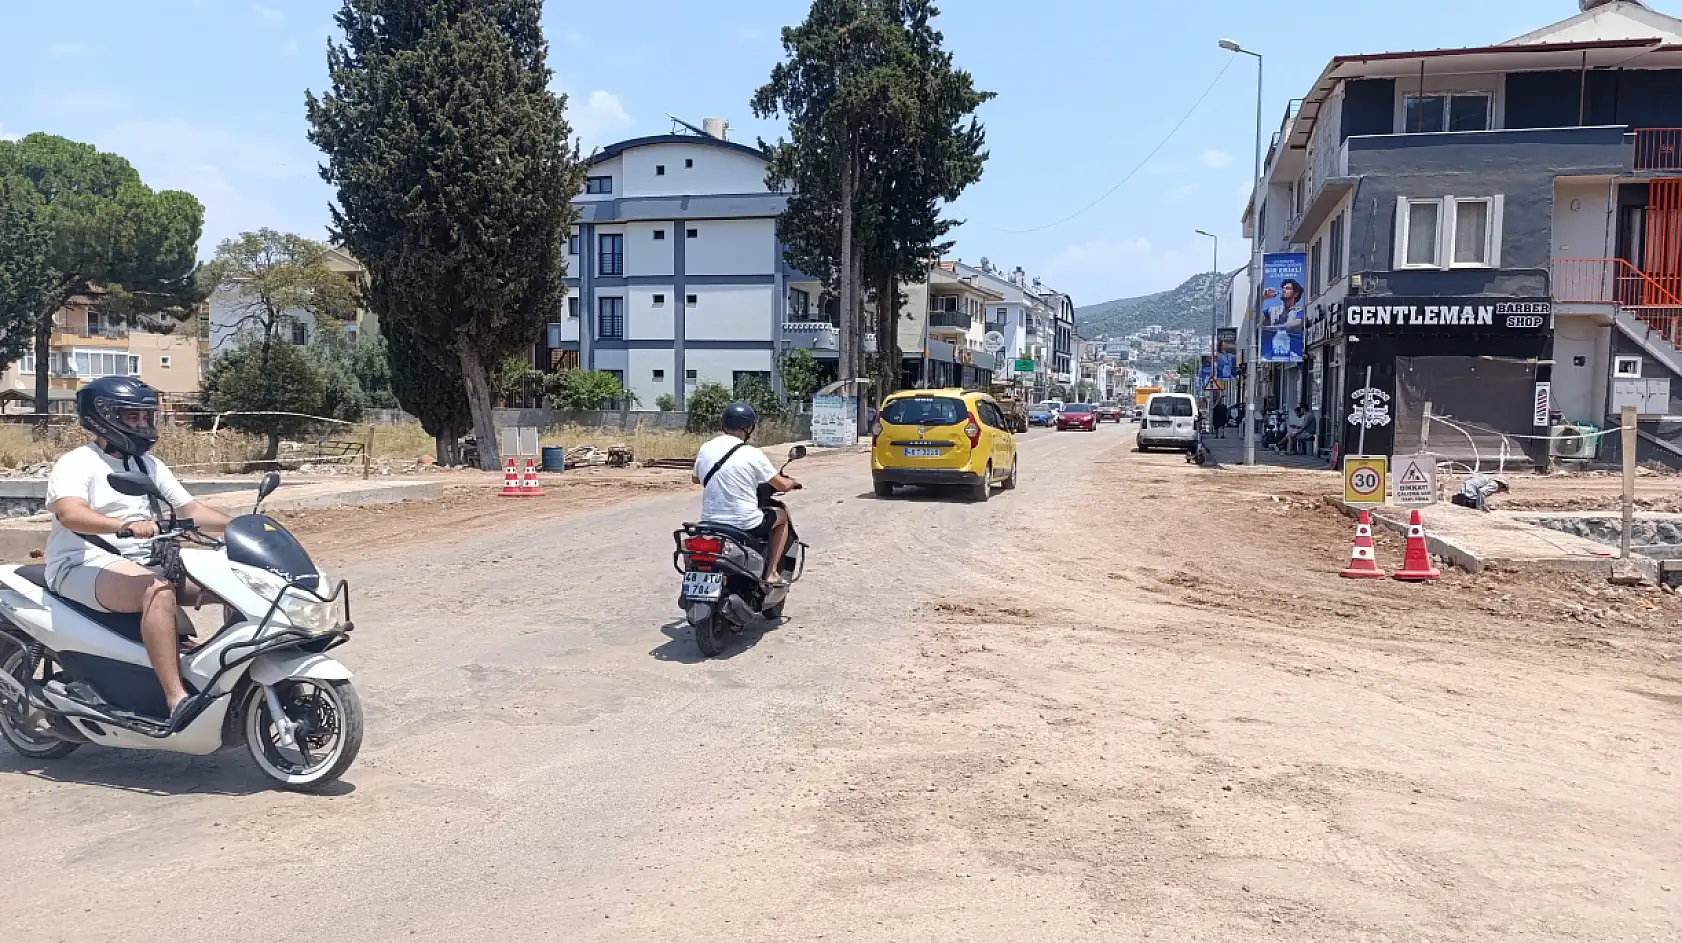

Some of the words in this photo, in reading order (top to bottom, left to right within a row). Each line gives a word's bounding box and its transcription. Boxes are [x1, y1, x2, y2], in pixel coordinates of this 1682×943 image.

[1496, 302, 1550, 314] BARBER
[1347, 305, 1494, 325] GENTLEMAN
[1506, 315, 1543, 328] SHOP
[1355, 474, 1375, 488] 30
[685, 573, 697, 582] 48
[692, 585, 709, 594] 704
